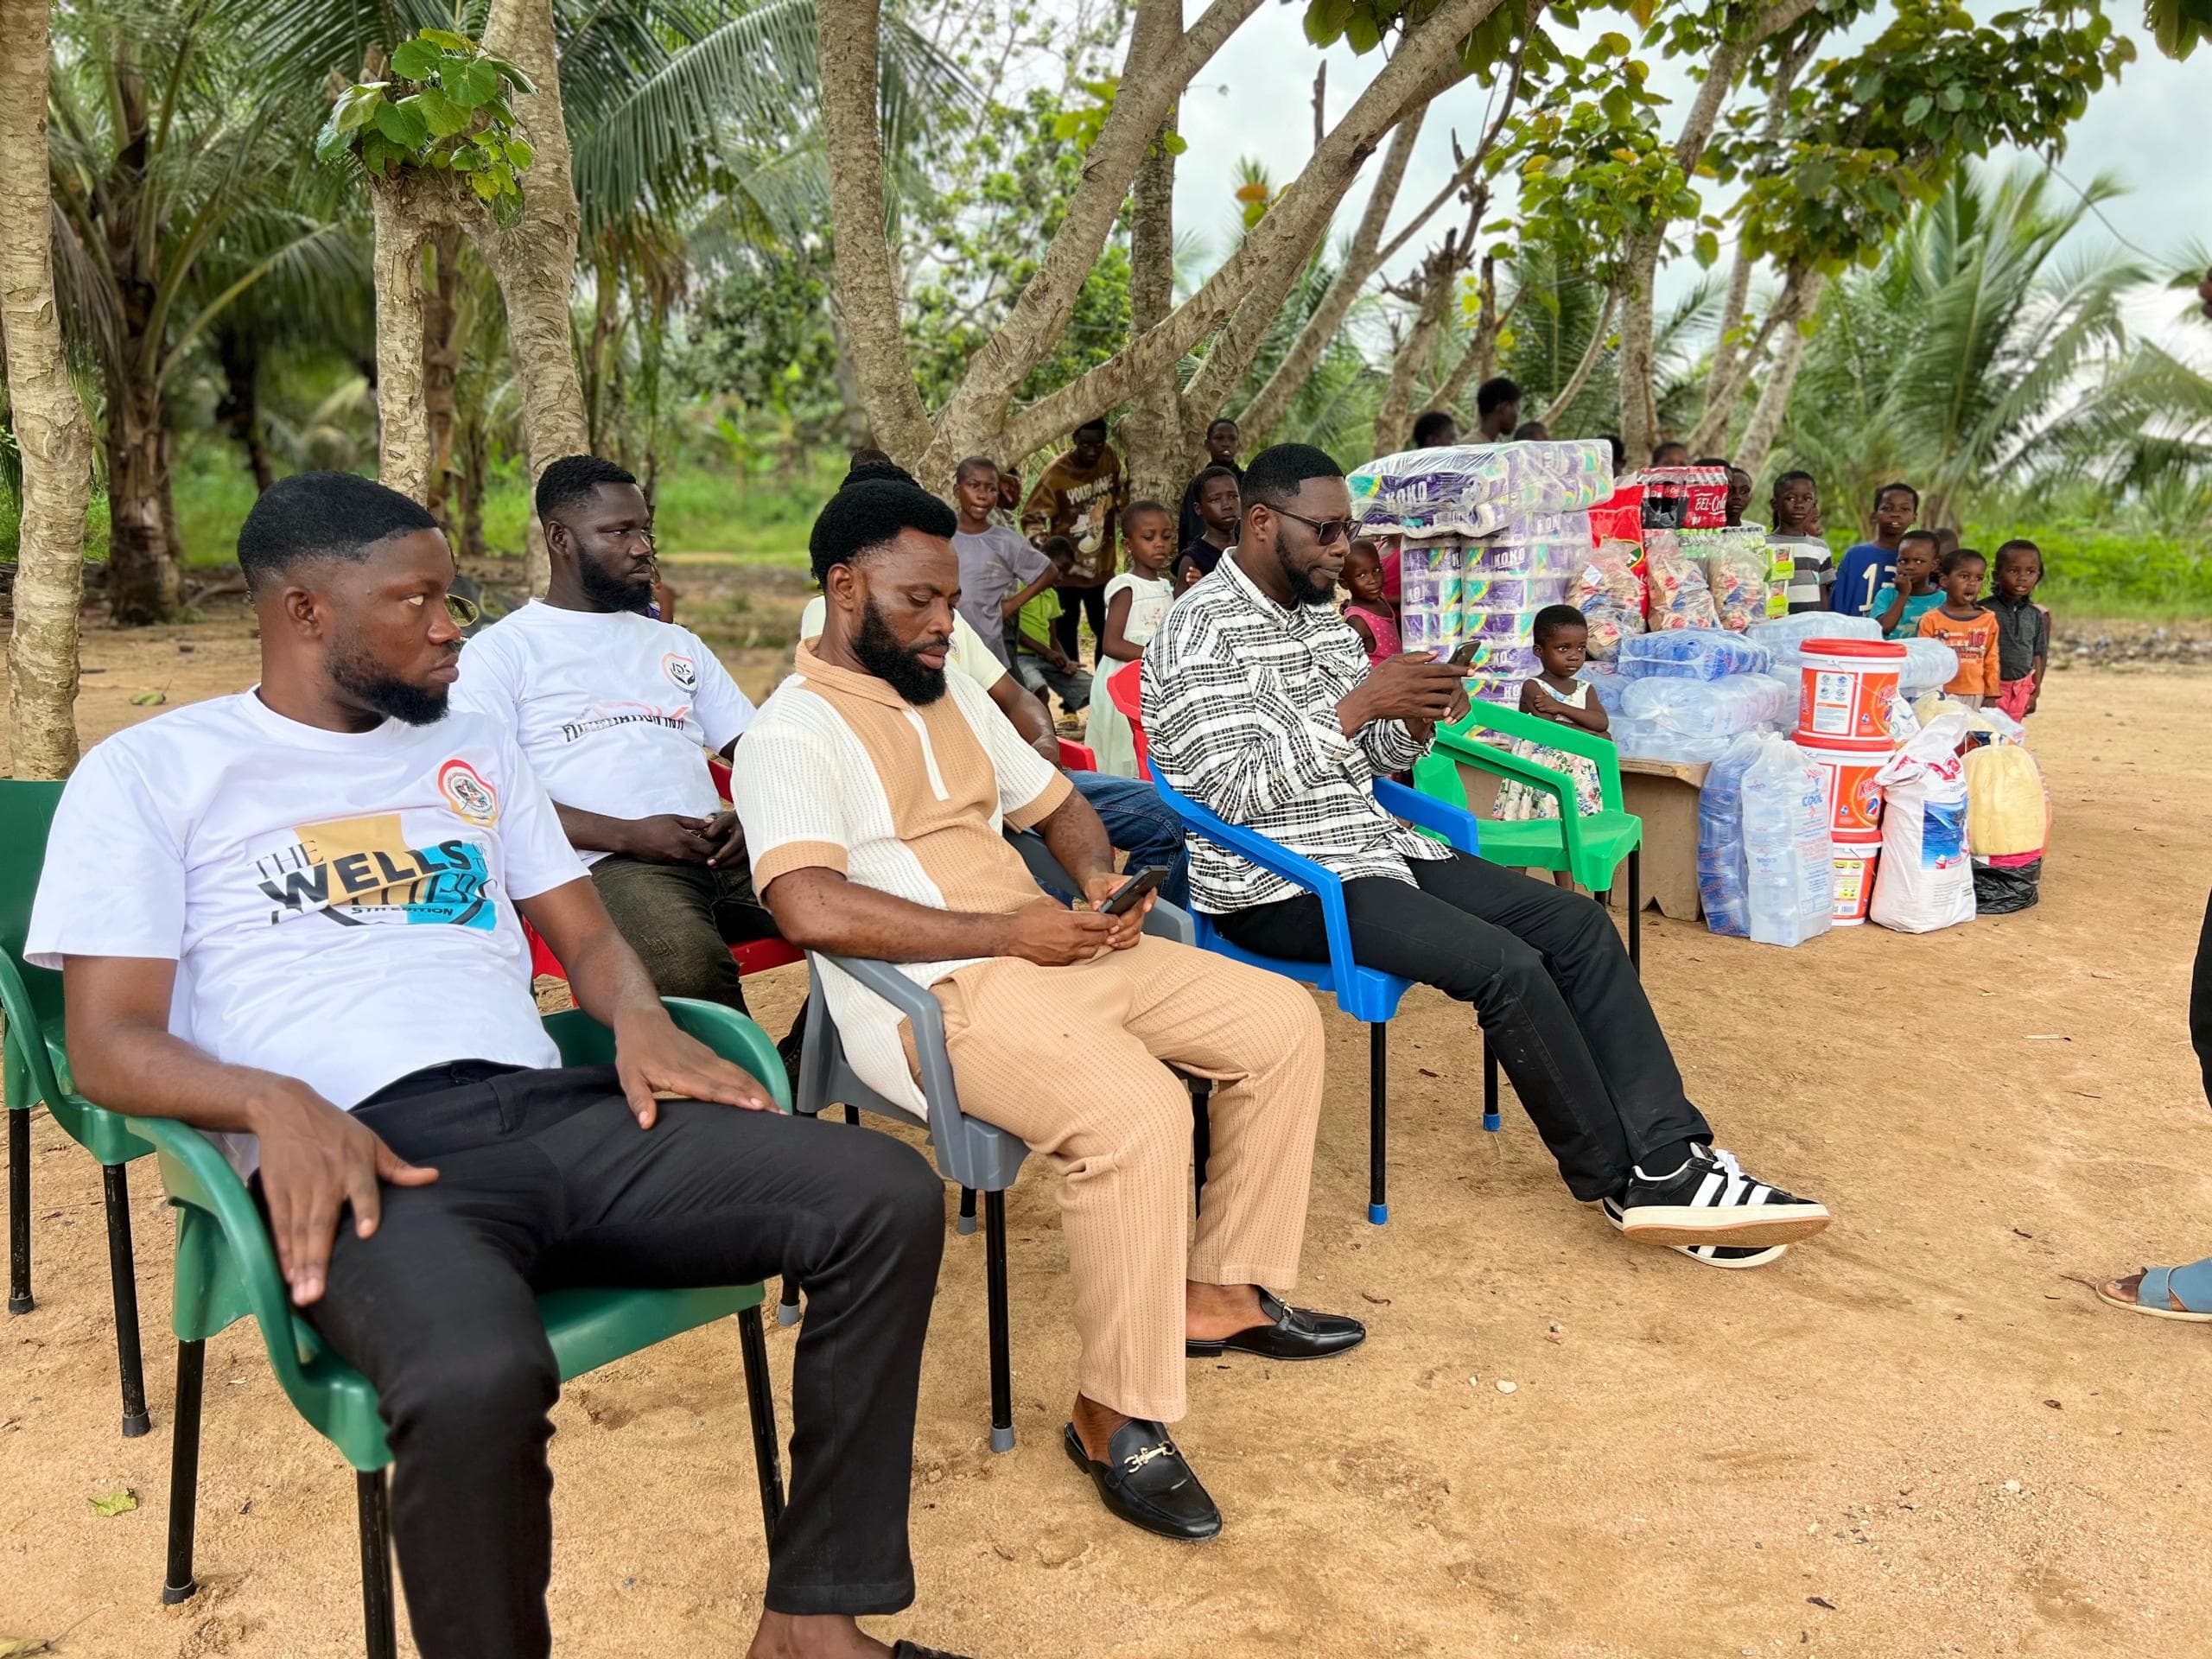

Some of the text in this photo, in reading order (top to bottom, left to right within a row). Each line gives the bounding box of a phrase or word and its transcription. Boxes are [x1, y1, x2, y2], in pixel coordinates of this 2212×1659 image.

[1386, 480, 1427, 506] KOKO
[1494, 547, 1525, 567] KOKO
[247, 840, 324, 880] THE
[257, 839, 472, 913] WELLS
